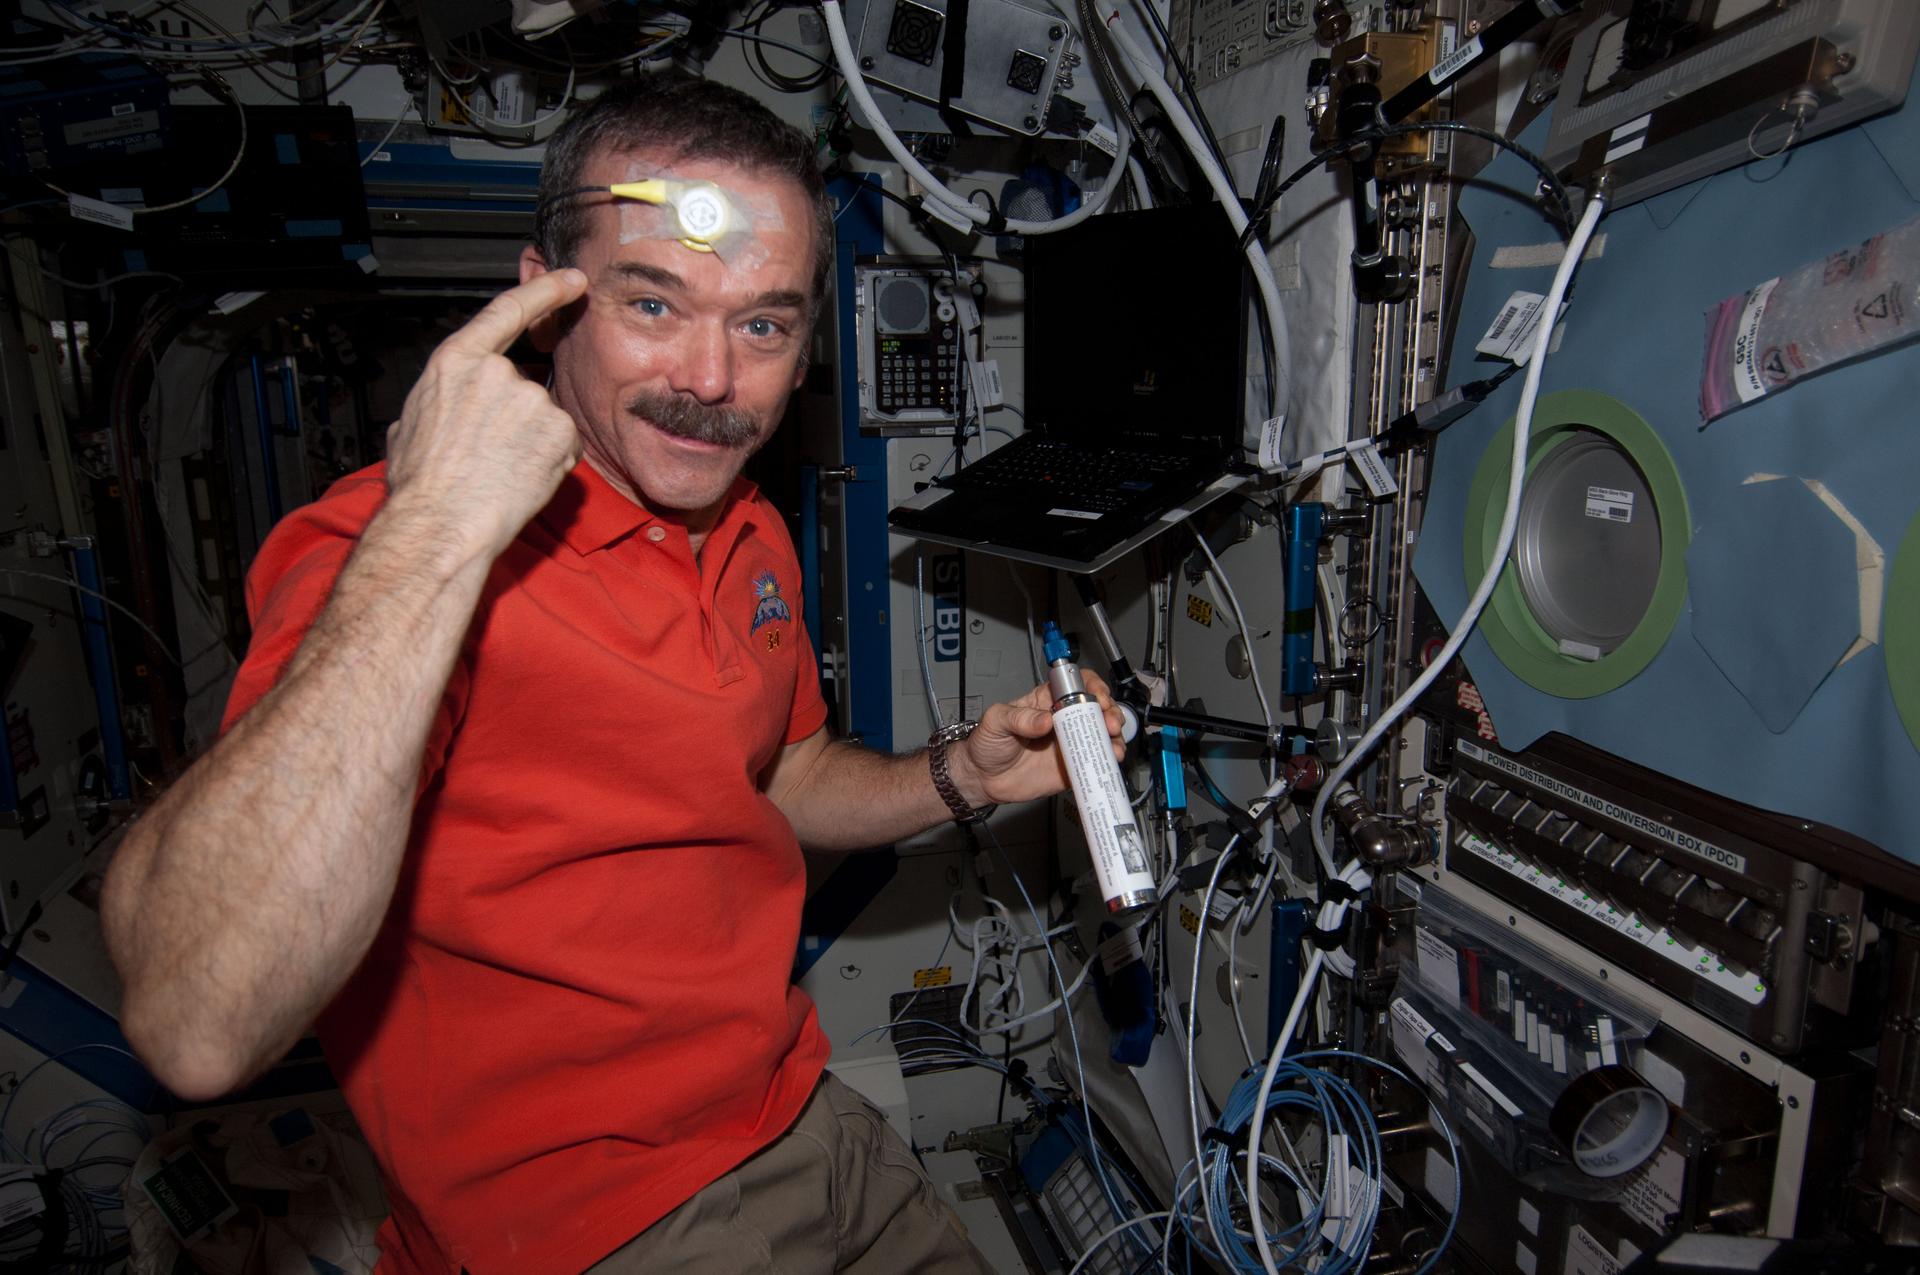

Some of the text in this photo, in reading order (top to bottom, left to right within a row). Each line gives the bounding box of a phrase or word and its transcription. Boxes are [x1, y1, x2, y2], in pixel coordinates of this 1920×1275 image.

[1736, 335, 1747, 364] GSC
[935, 560, 960, 655] STBD
[766, 628, 779, 652] 34
[1487, 753, 1739, 868] POWER DISTRIBUTION AND CONVERSION BOX (PDC)
[1594, 908, 1618, 926] AIRLOCK
[1395, 1001, 1409, 1015] Digital
[1407, 1012, 1418, 1024] Tape
[153, 1175, 195, 1229] TECHNICAL
[1577, 1231, 1615, 1269] LOGISTICS
